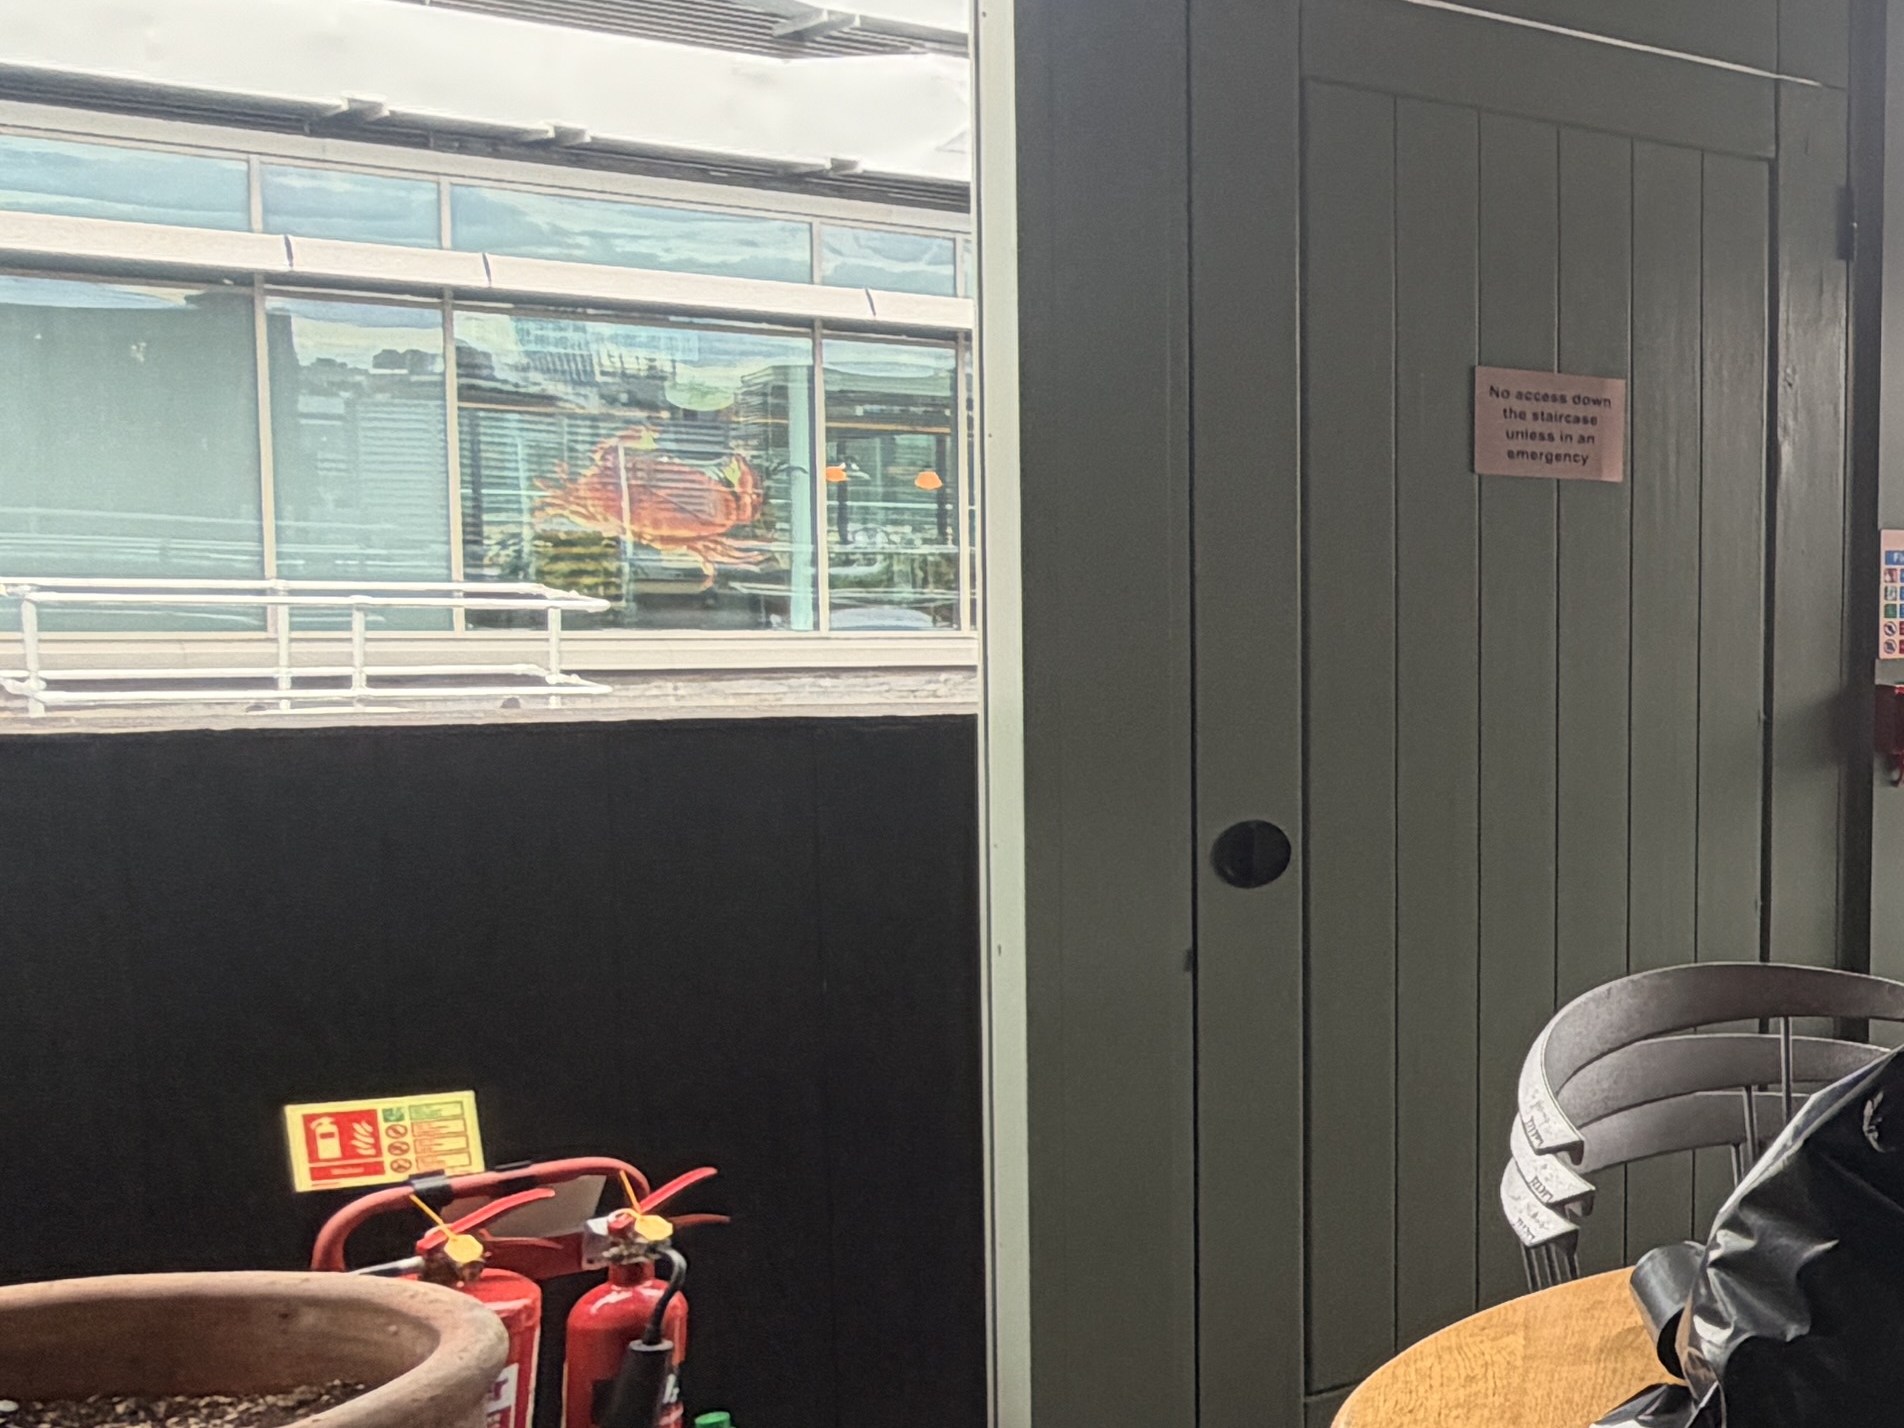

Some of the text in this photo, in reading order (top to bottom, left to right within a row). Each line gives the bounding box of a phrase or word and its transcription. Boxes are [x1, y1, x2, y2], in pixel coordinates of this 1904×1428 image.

[1489, 385, 1612, 408] No access down
[1502, 408, 1598, 426] the staircase
[1506, 428, 1596, 445] unless in an
[1507, 448, 1589, 466] emergency
